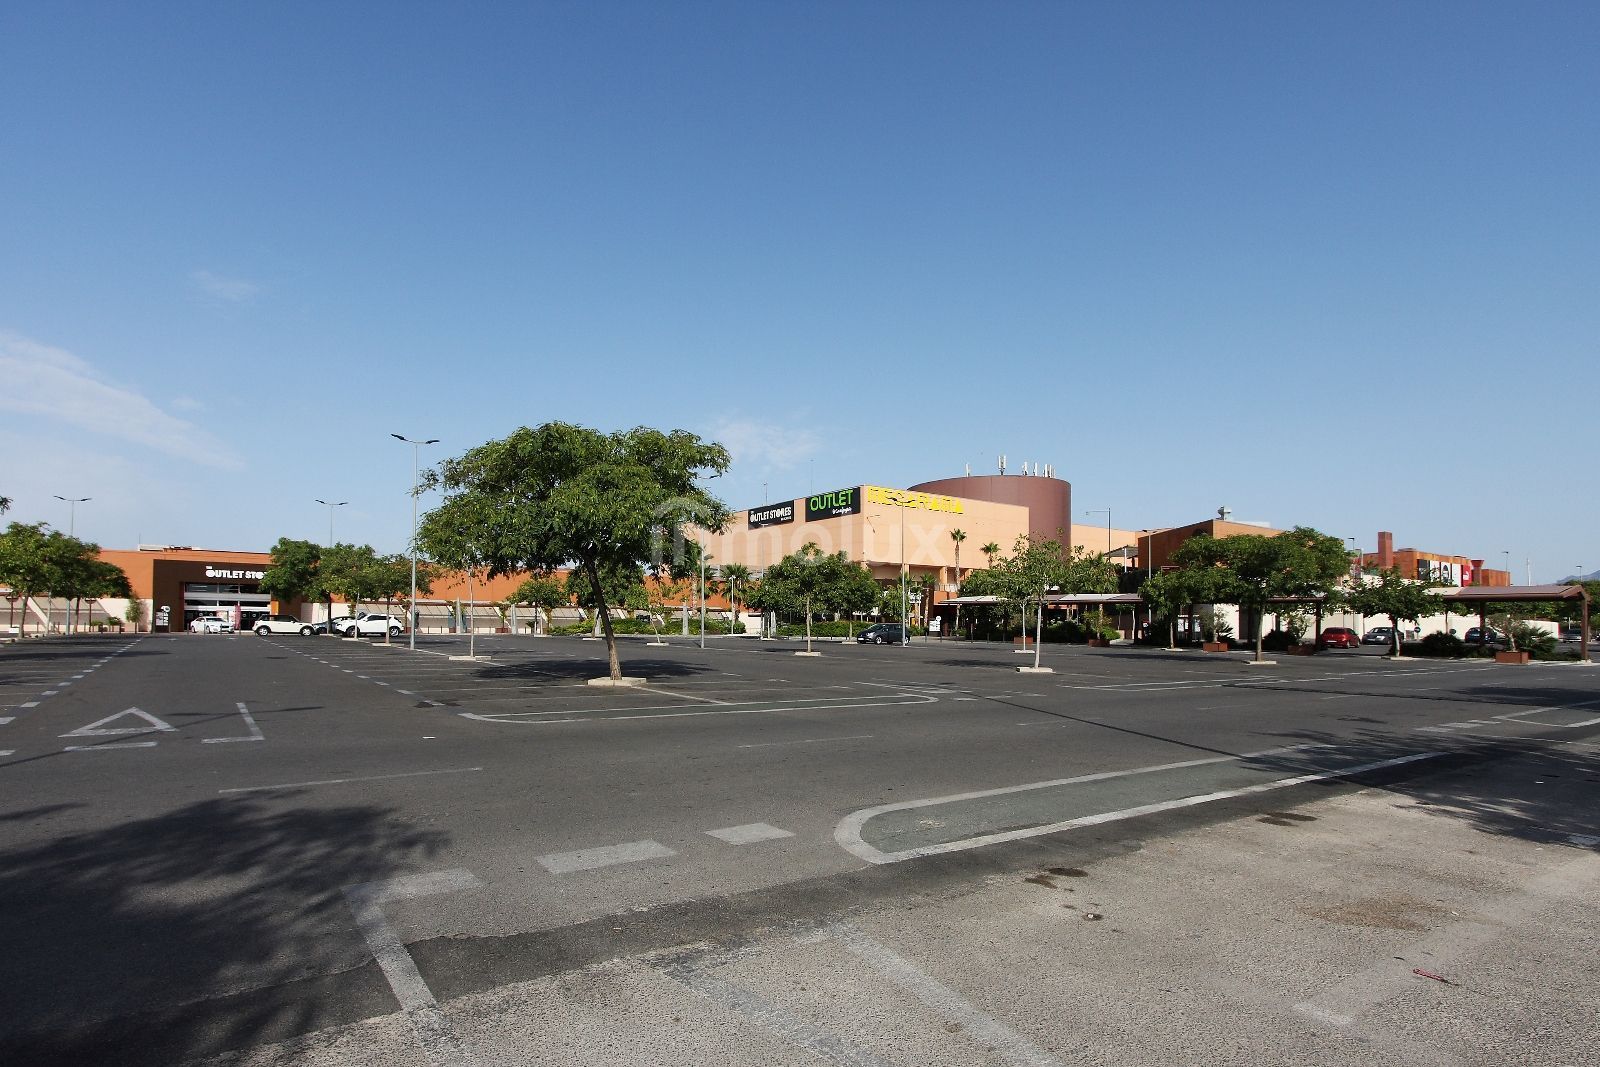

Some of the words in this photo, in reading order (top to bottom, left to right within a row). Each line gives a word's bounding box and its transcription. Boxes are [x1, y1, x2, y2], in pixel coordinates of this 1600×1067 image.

[810, 489, 853, 511] OUTLET
[750, 512, 769, 523] OUTLET
[770, 507, 791, 519] STORES
[205, 569, 244, 579] OUTLET
[245, 571, 267, 580] STO
